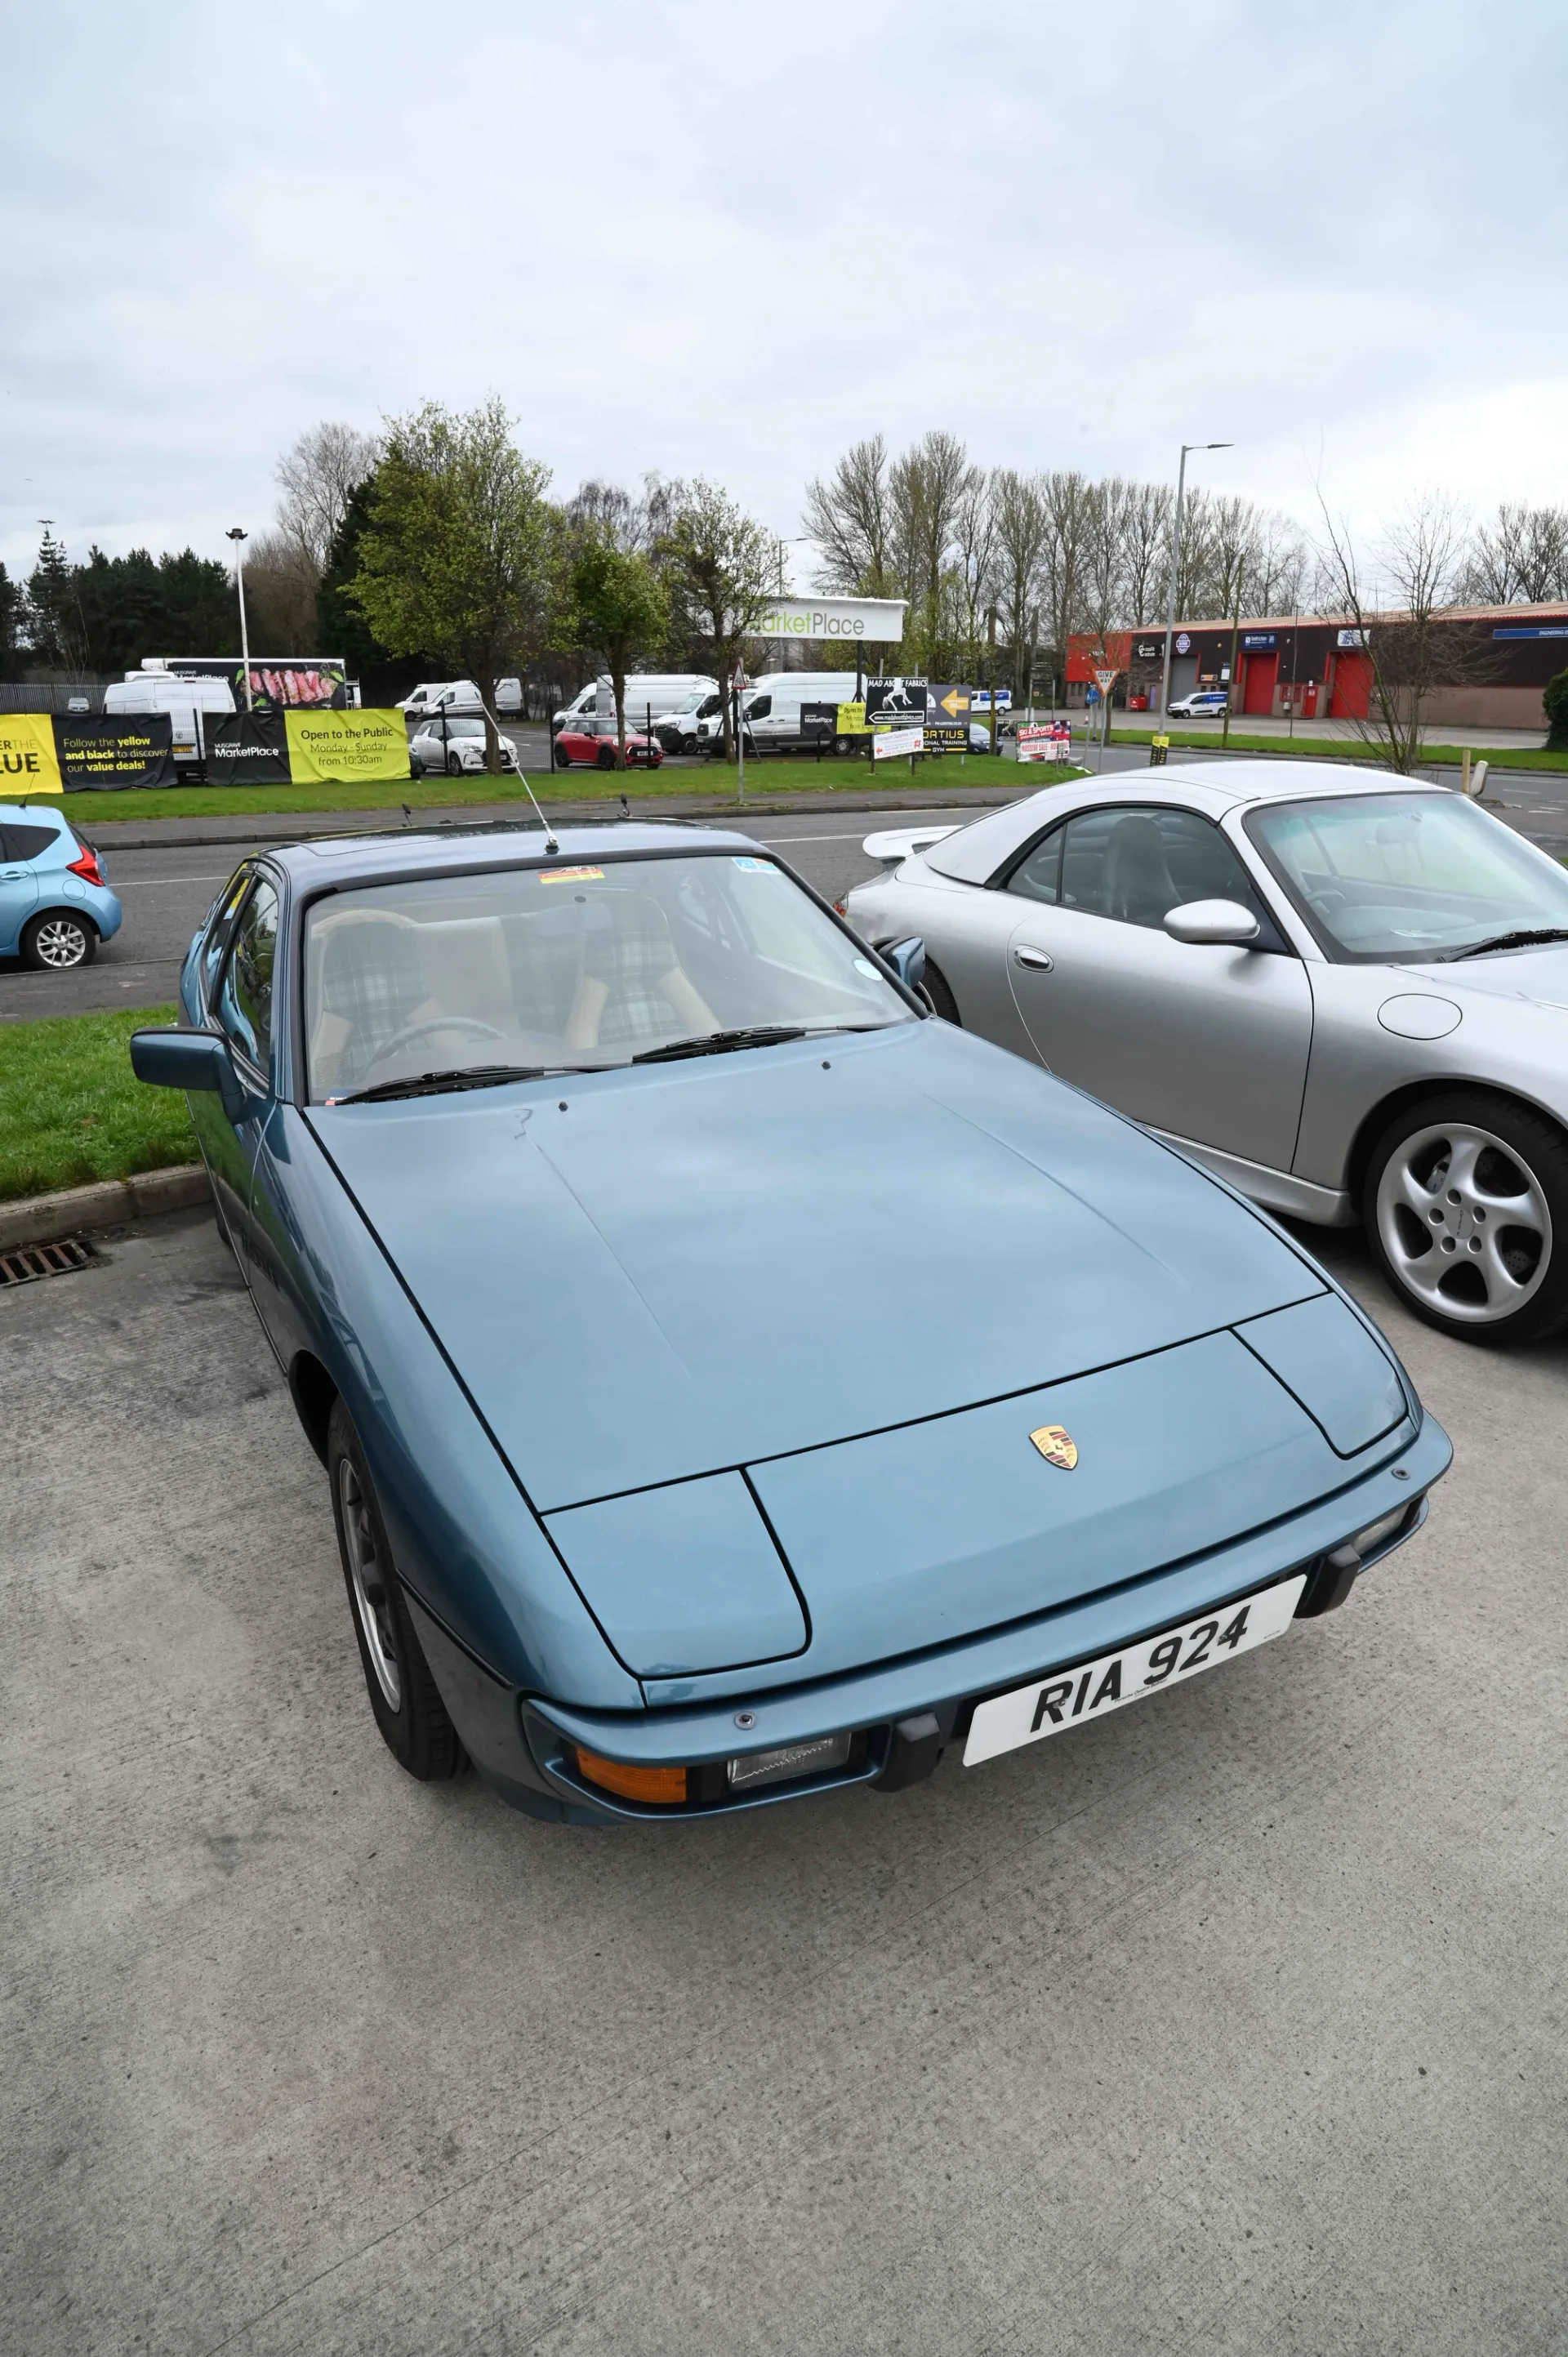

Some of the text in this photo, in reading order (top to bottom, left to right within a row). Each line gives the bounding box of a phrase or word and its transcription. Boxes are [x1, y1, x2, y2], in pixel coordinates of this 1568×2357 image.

[751, 612, 864, 635] arketPlace
[884, 679, 904, 687] ABT
[924, 730, 964, 739] ORTIUS
[1033, 724, 1054, 733] SPORTS
[301, 728, 394, 742] Open to the Public
[64, 736, 150, 749] Follow the yellow
[310, 743, 348, 755] Monday
[355, 742, 387, 753] Sunday
[1022, 743, 1038, 751] MASSIVE
[65, 751, 85, 760] and
[87, 750, 114, 760] black
[117, 750, 127, 759] to
[130, 748, 169, 758] discover
[215, 747, 279, 758] MarketPlace
[0, 752, 41, 774] UE
[318, 755, 382, 766] from 10:30am
[67, 761, 145, 773] our value deals!
[1030, 1604, 1251, 1733] RIA 924
